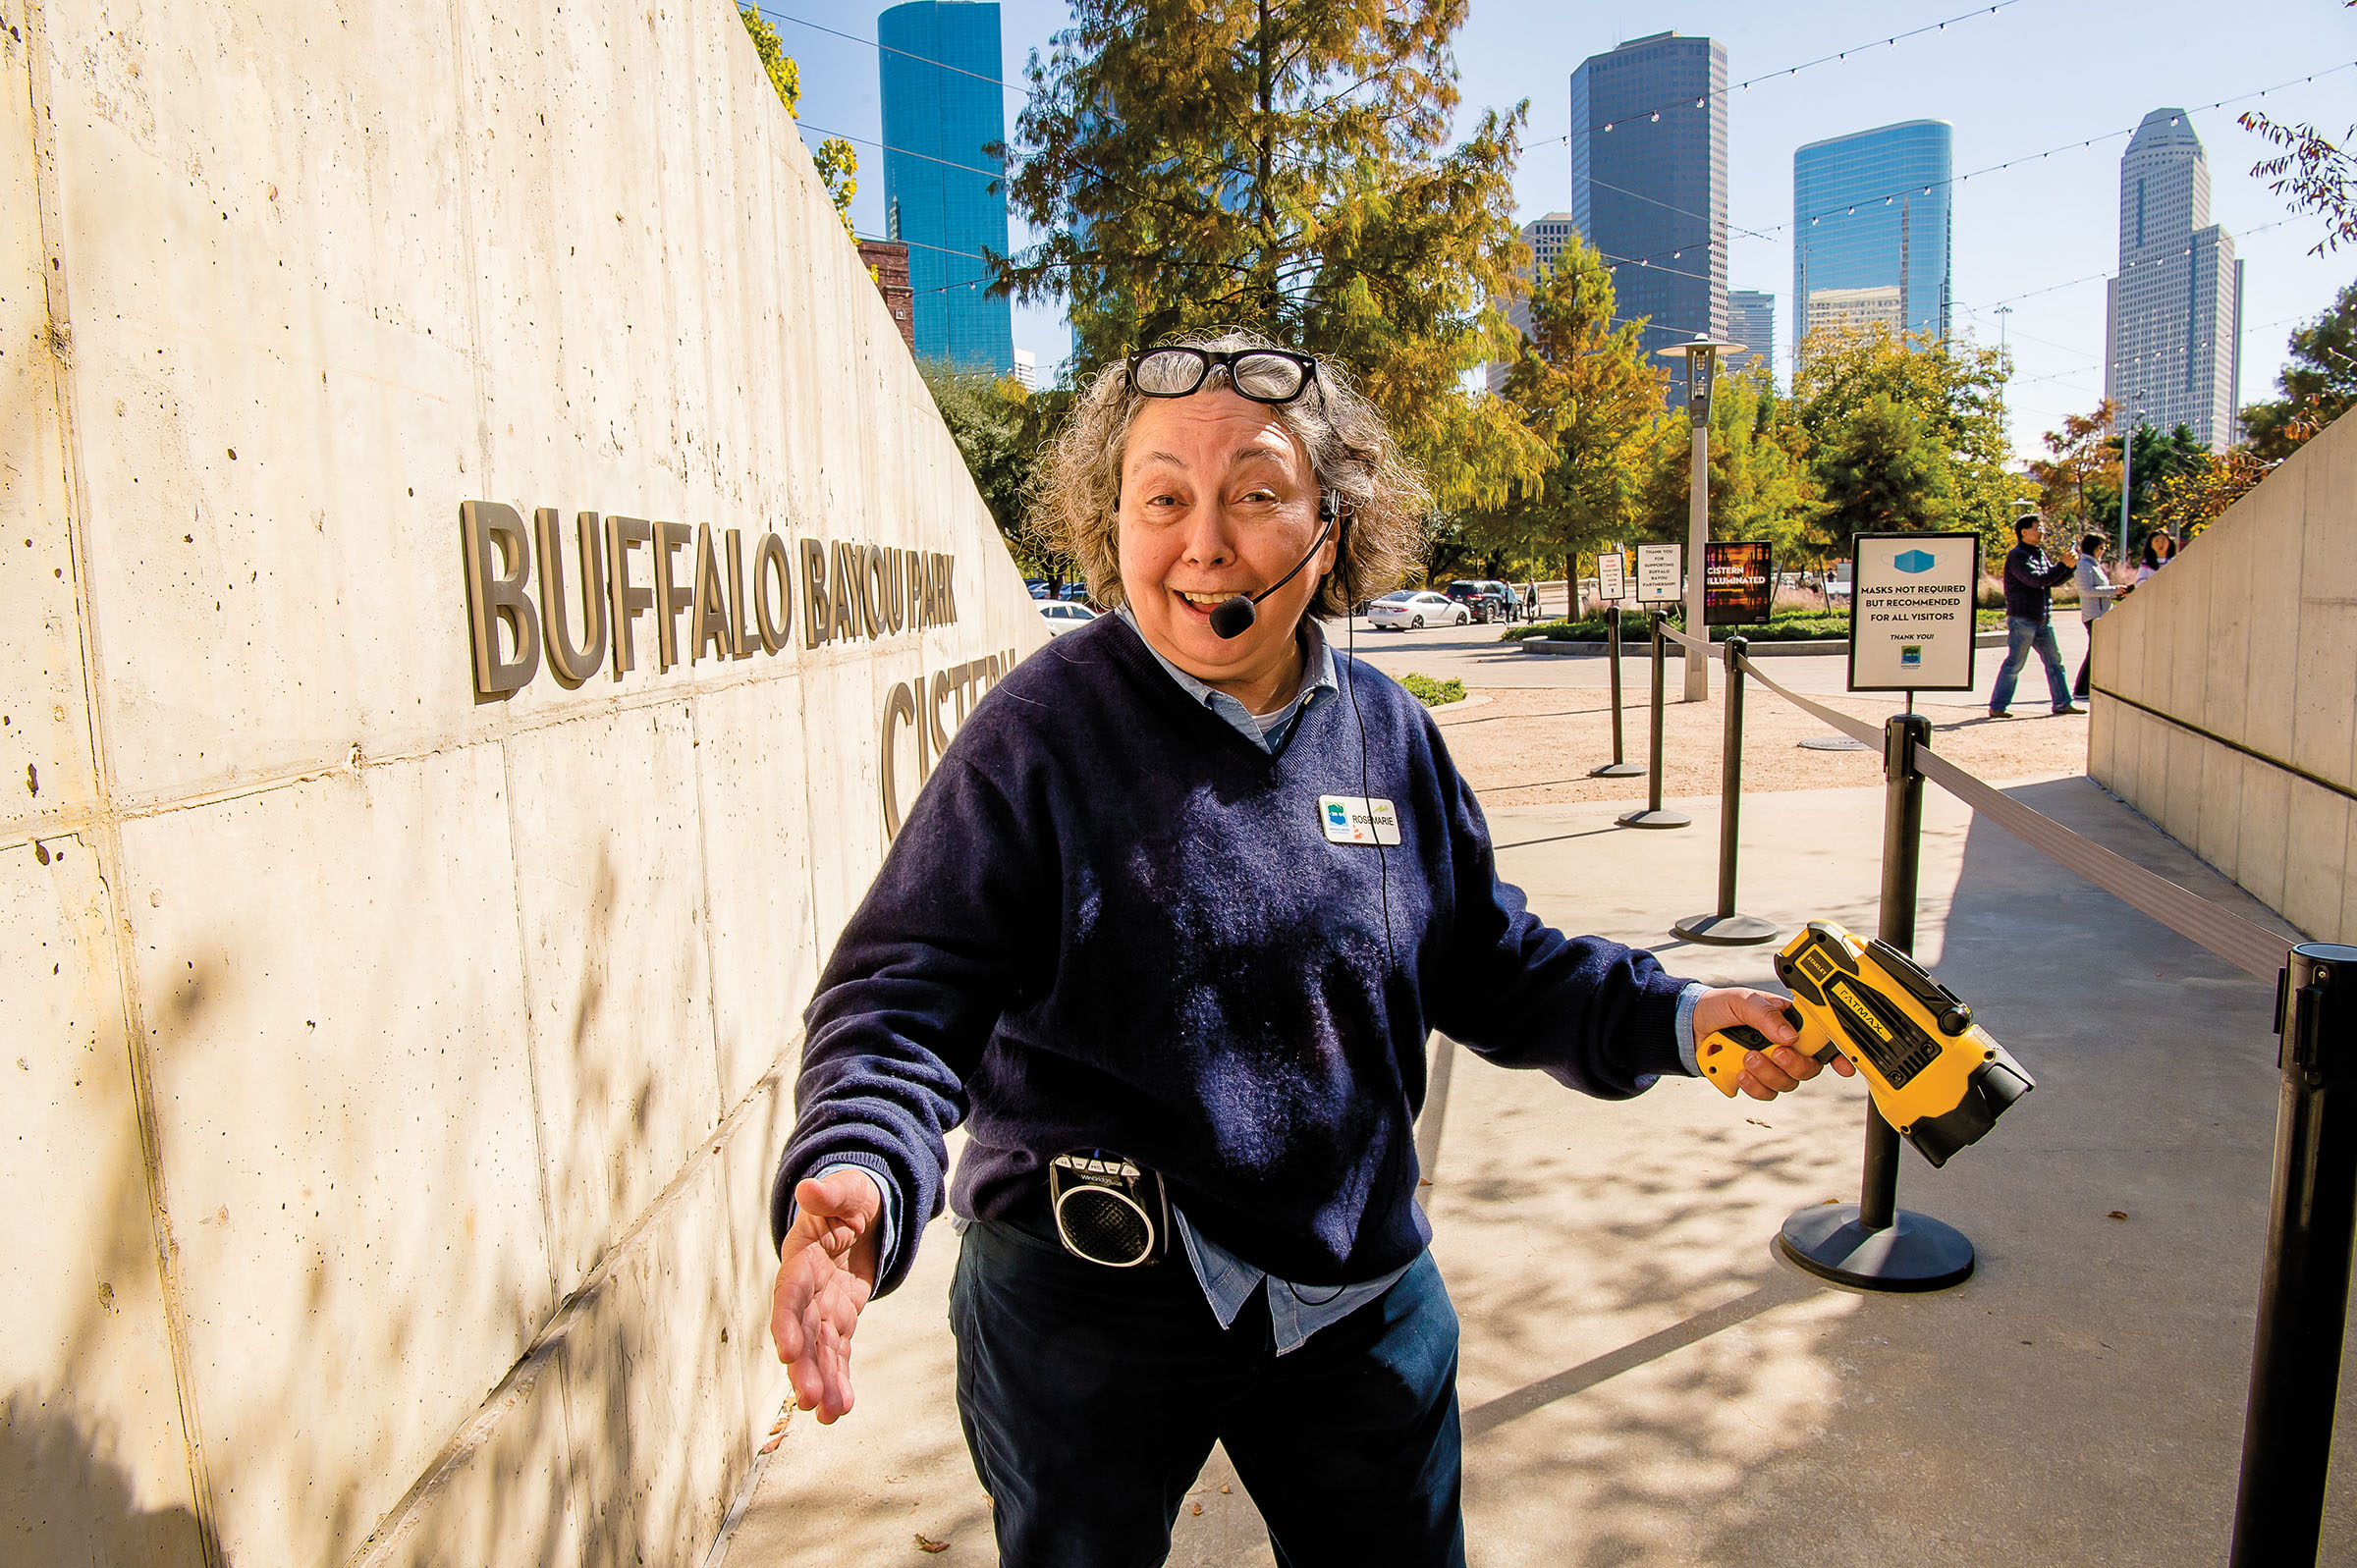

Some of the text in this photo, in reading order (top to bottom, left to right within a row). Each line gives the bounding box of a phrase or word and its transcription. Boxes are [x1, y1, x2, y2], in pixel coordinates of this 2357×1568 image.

[462, 500, 959, 695] BUFFALO BAYOU PARK
[1918, 585, 1966, 594] REQUIRED
[1886, 598, 1960, 607] RECOMMENDED
[882, 648, 1015, 845] CIST
[1351, 814, 1395, 826] ROSEMARIE
[1806, 955, 1828, 975] STANLEY
